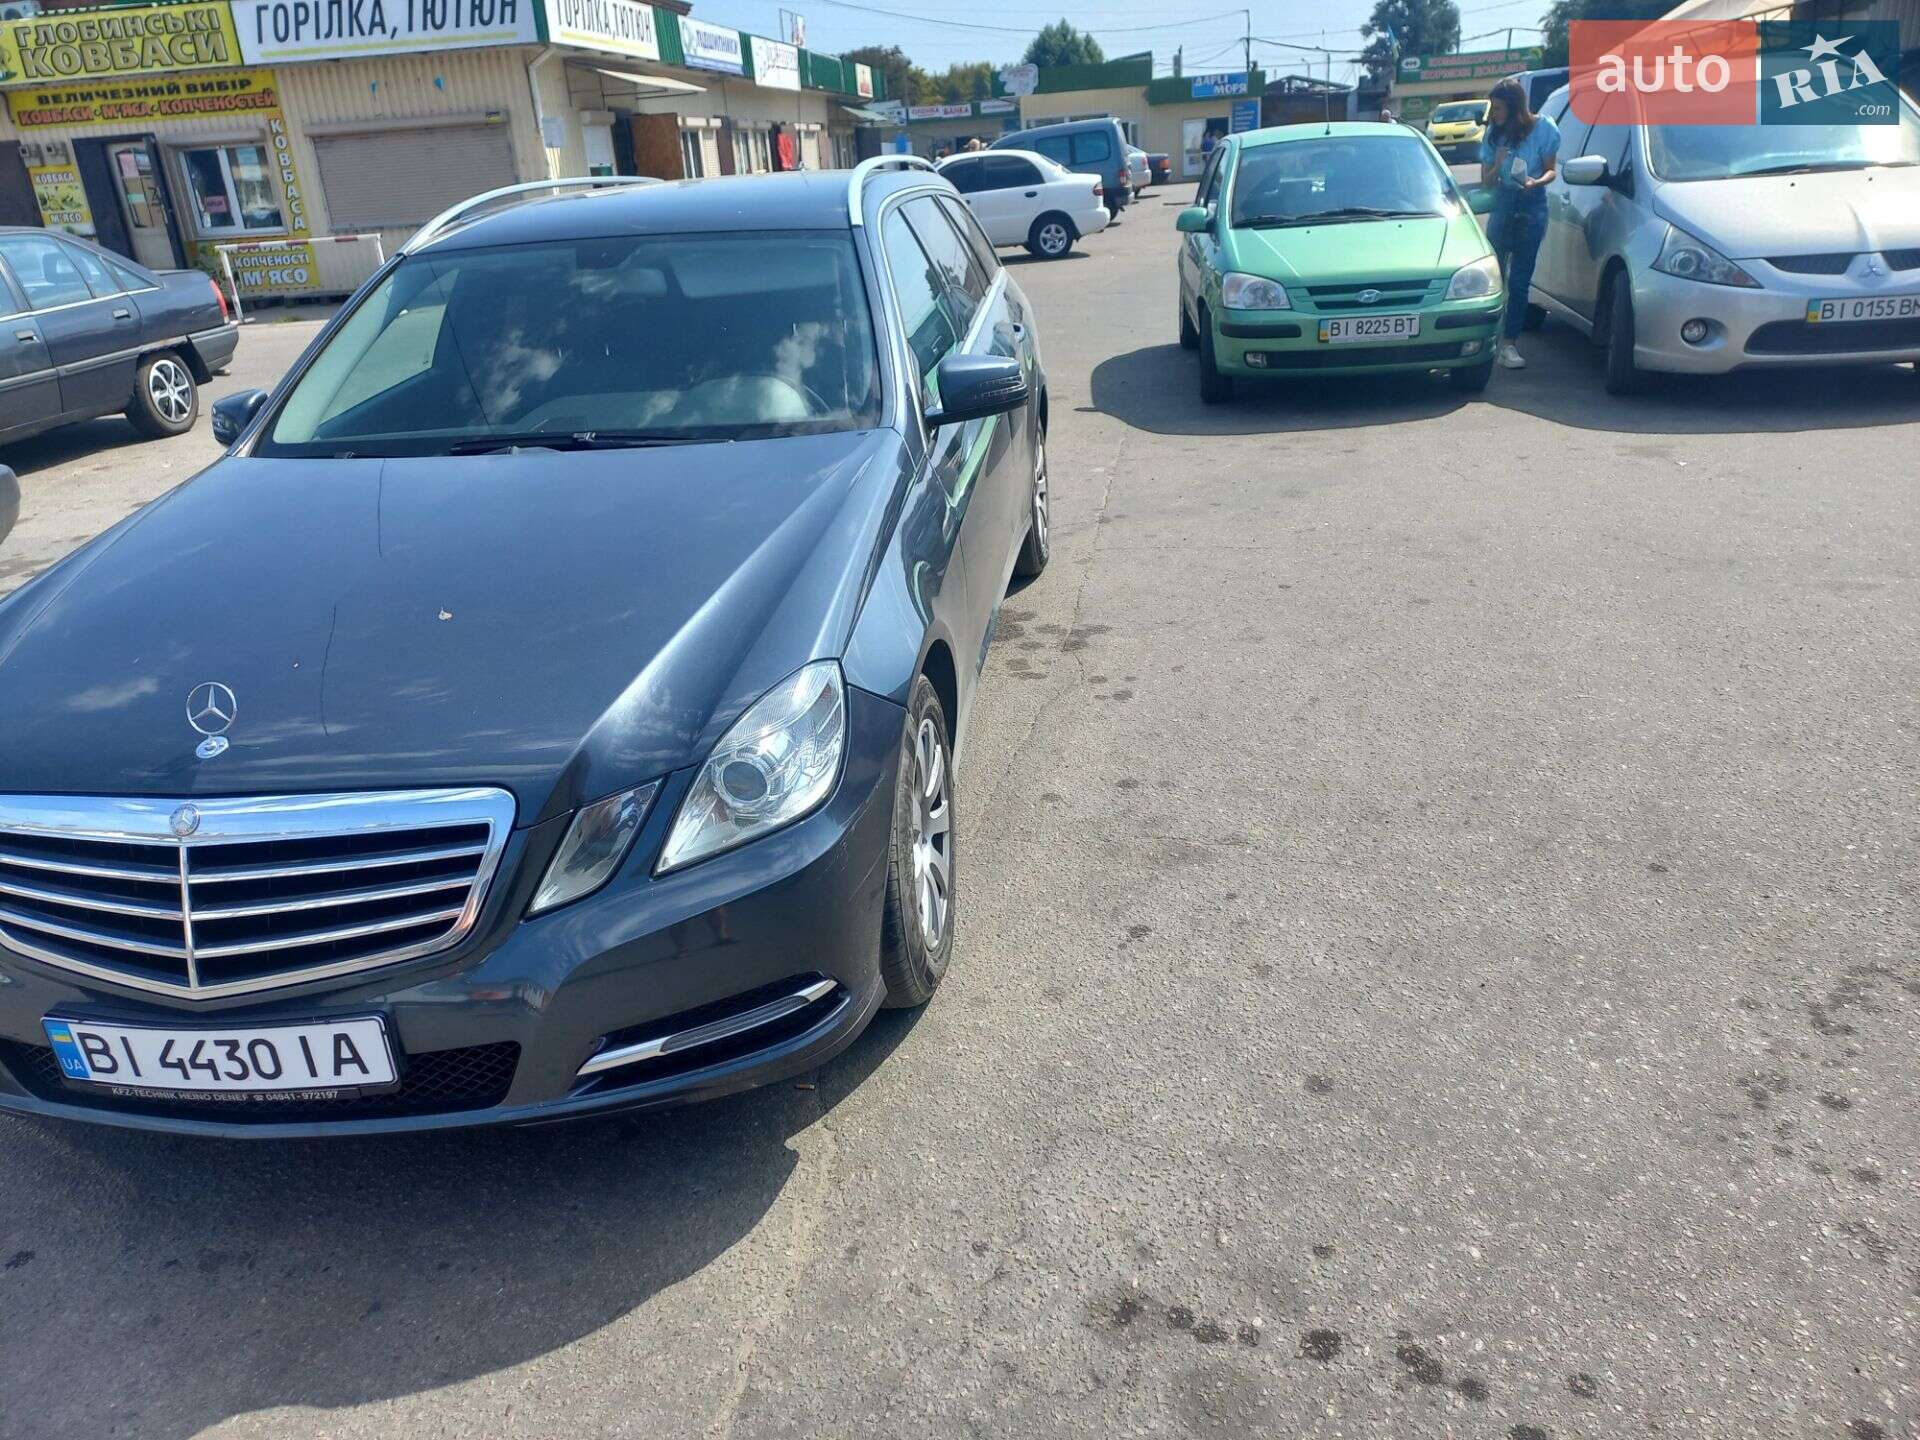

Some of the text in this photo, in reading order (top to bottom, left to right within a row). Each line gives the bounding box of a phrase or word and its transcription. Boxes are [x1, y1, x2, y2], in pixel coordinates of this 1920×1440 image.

[14, 8, 222, 48] ГЛОБИНСЬКІ
[19, 31, 229, 79] КОВБАСИ
[37, 78, 253, 105] ВЕЛИЧЕЗНИЙ ВИБІР
[159, 88, 278, 116] КОПЧЕНОСТЕЙ
[270, 118, 307, 231] КОВБАСА
[242, 267, 309, 287] М'ЯСО
[1822, 302, 1845, 319] BI
[1853, 300, 1896, 317] 0155
[1330, 317, 1417, 337] BI 8225 BT
[62, 1056, 84, 1073] UA
[77, 1032, 370, 1082] BI 4430 IA
[112, 1086, 177, 1100] KFZ-TECHNIK
